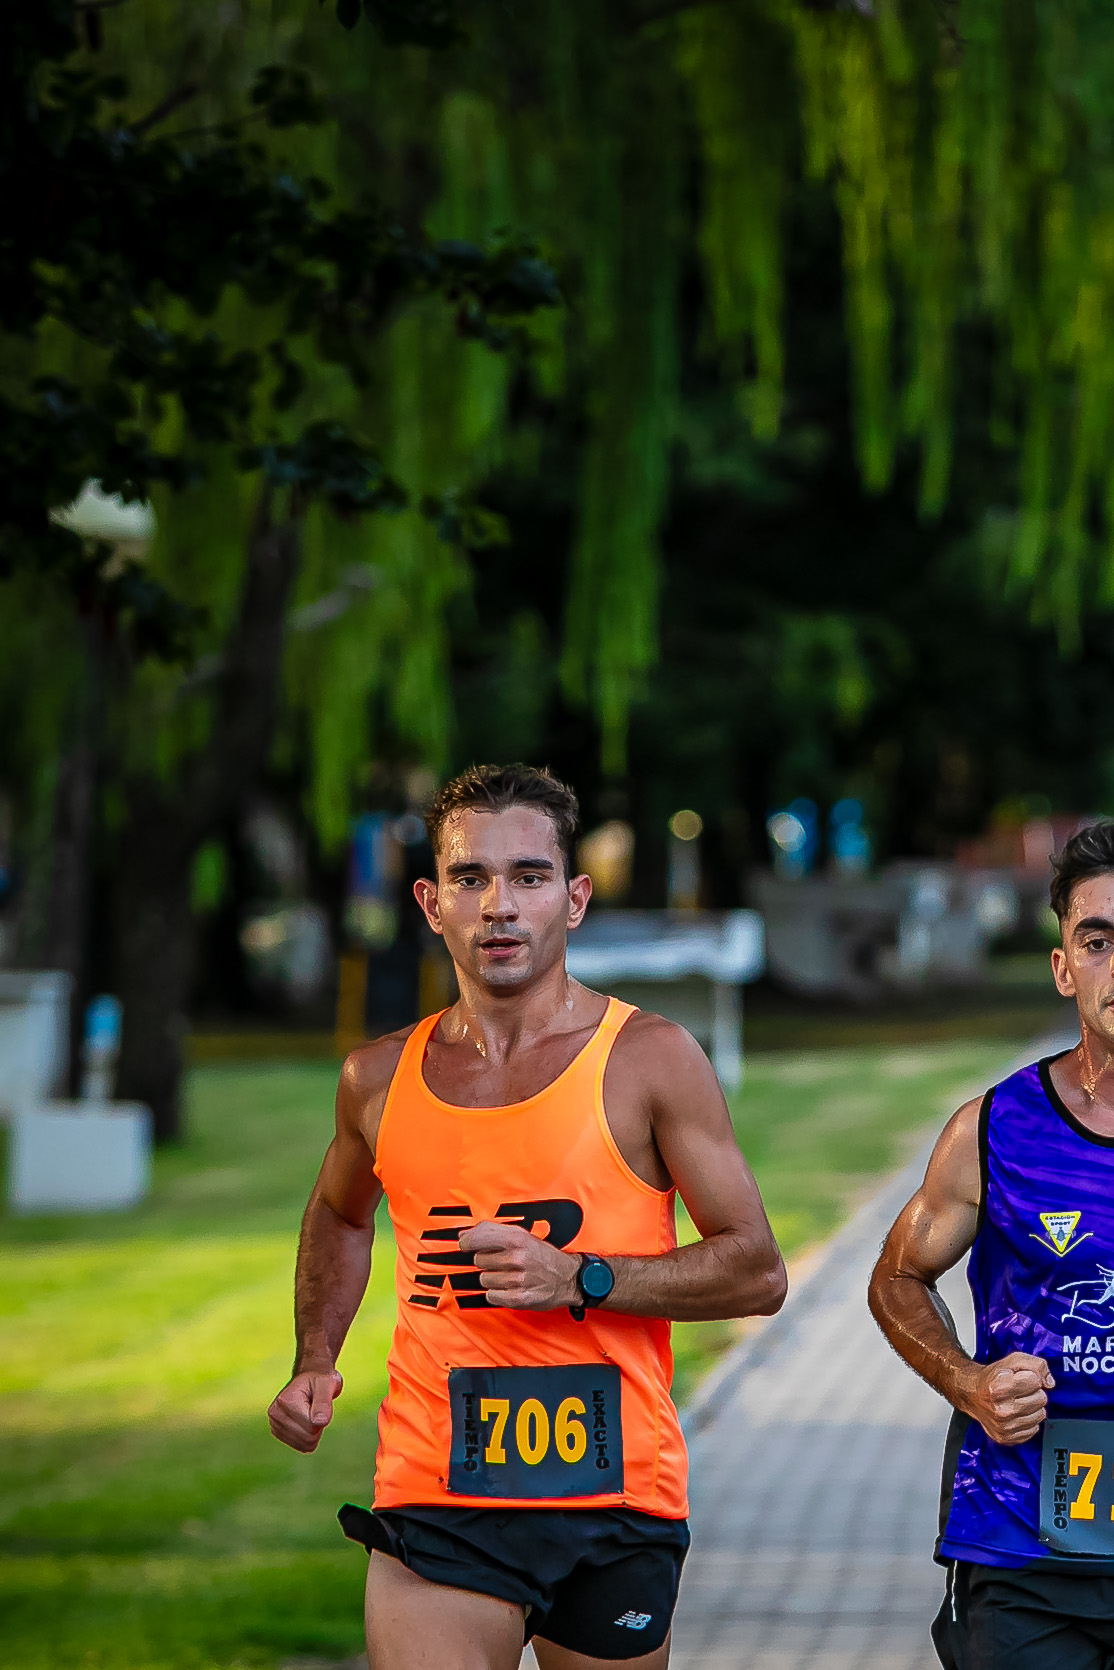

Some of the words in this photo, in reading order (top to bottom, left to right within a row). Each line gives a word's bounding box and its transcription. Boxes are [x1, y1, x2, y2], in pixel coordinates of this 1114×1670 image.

[462, 1392, 479, 1472] TIEMPO
[480, 1396, 587, 1466] 706
[592, 1389, 610, 1470] EXACTO
[1053, 1448, 1069, 1530] TIEMPO
